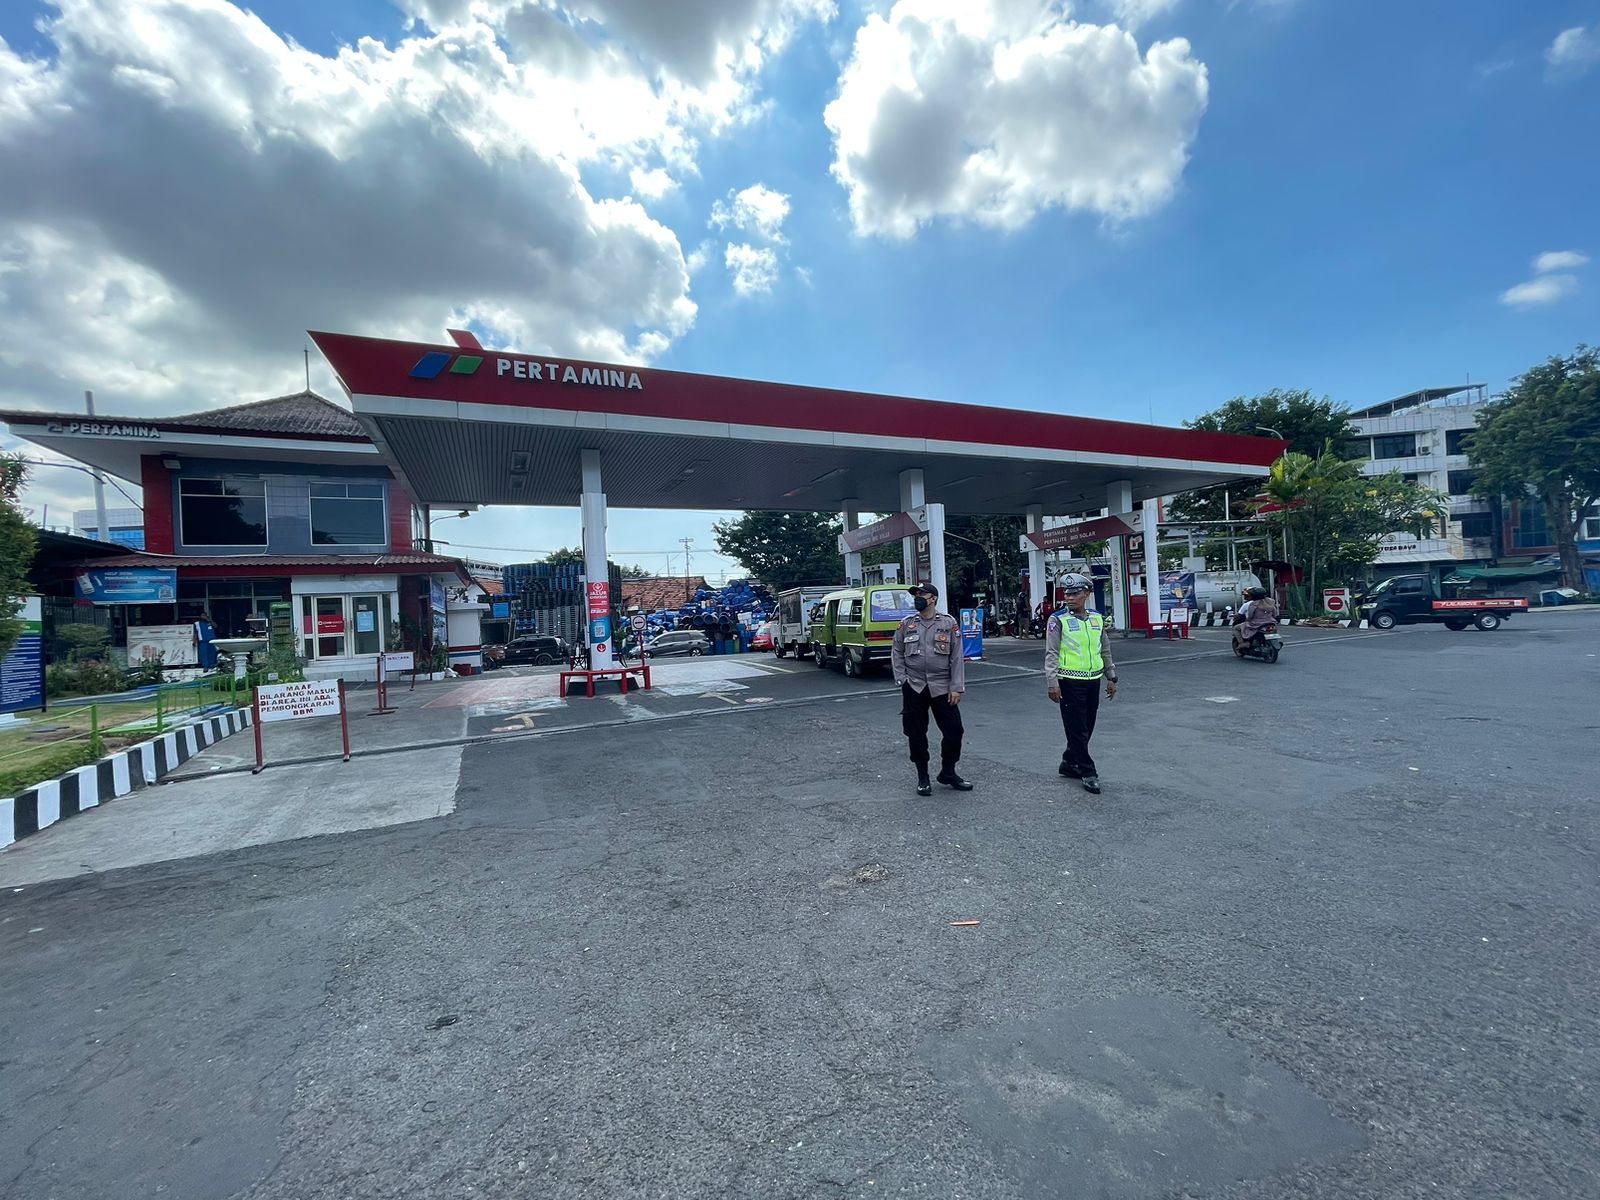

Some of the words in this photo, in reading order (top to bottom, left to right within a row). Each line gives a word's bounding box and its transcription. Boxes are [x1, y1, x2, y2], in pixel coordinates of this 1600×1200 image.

[497, 358, 643, 390] PERTAMINA
[69, 422, 160, 438] PERTAMINA
[1079, 531, 1097, 539] SOLAR
[260, 690, 305, 700] DILARANG
[307, 687, 336, 695] MASUK
[261, 700, 334, 712] PEMBONGKARAN
[293, 708, 314, 716] BBM
